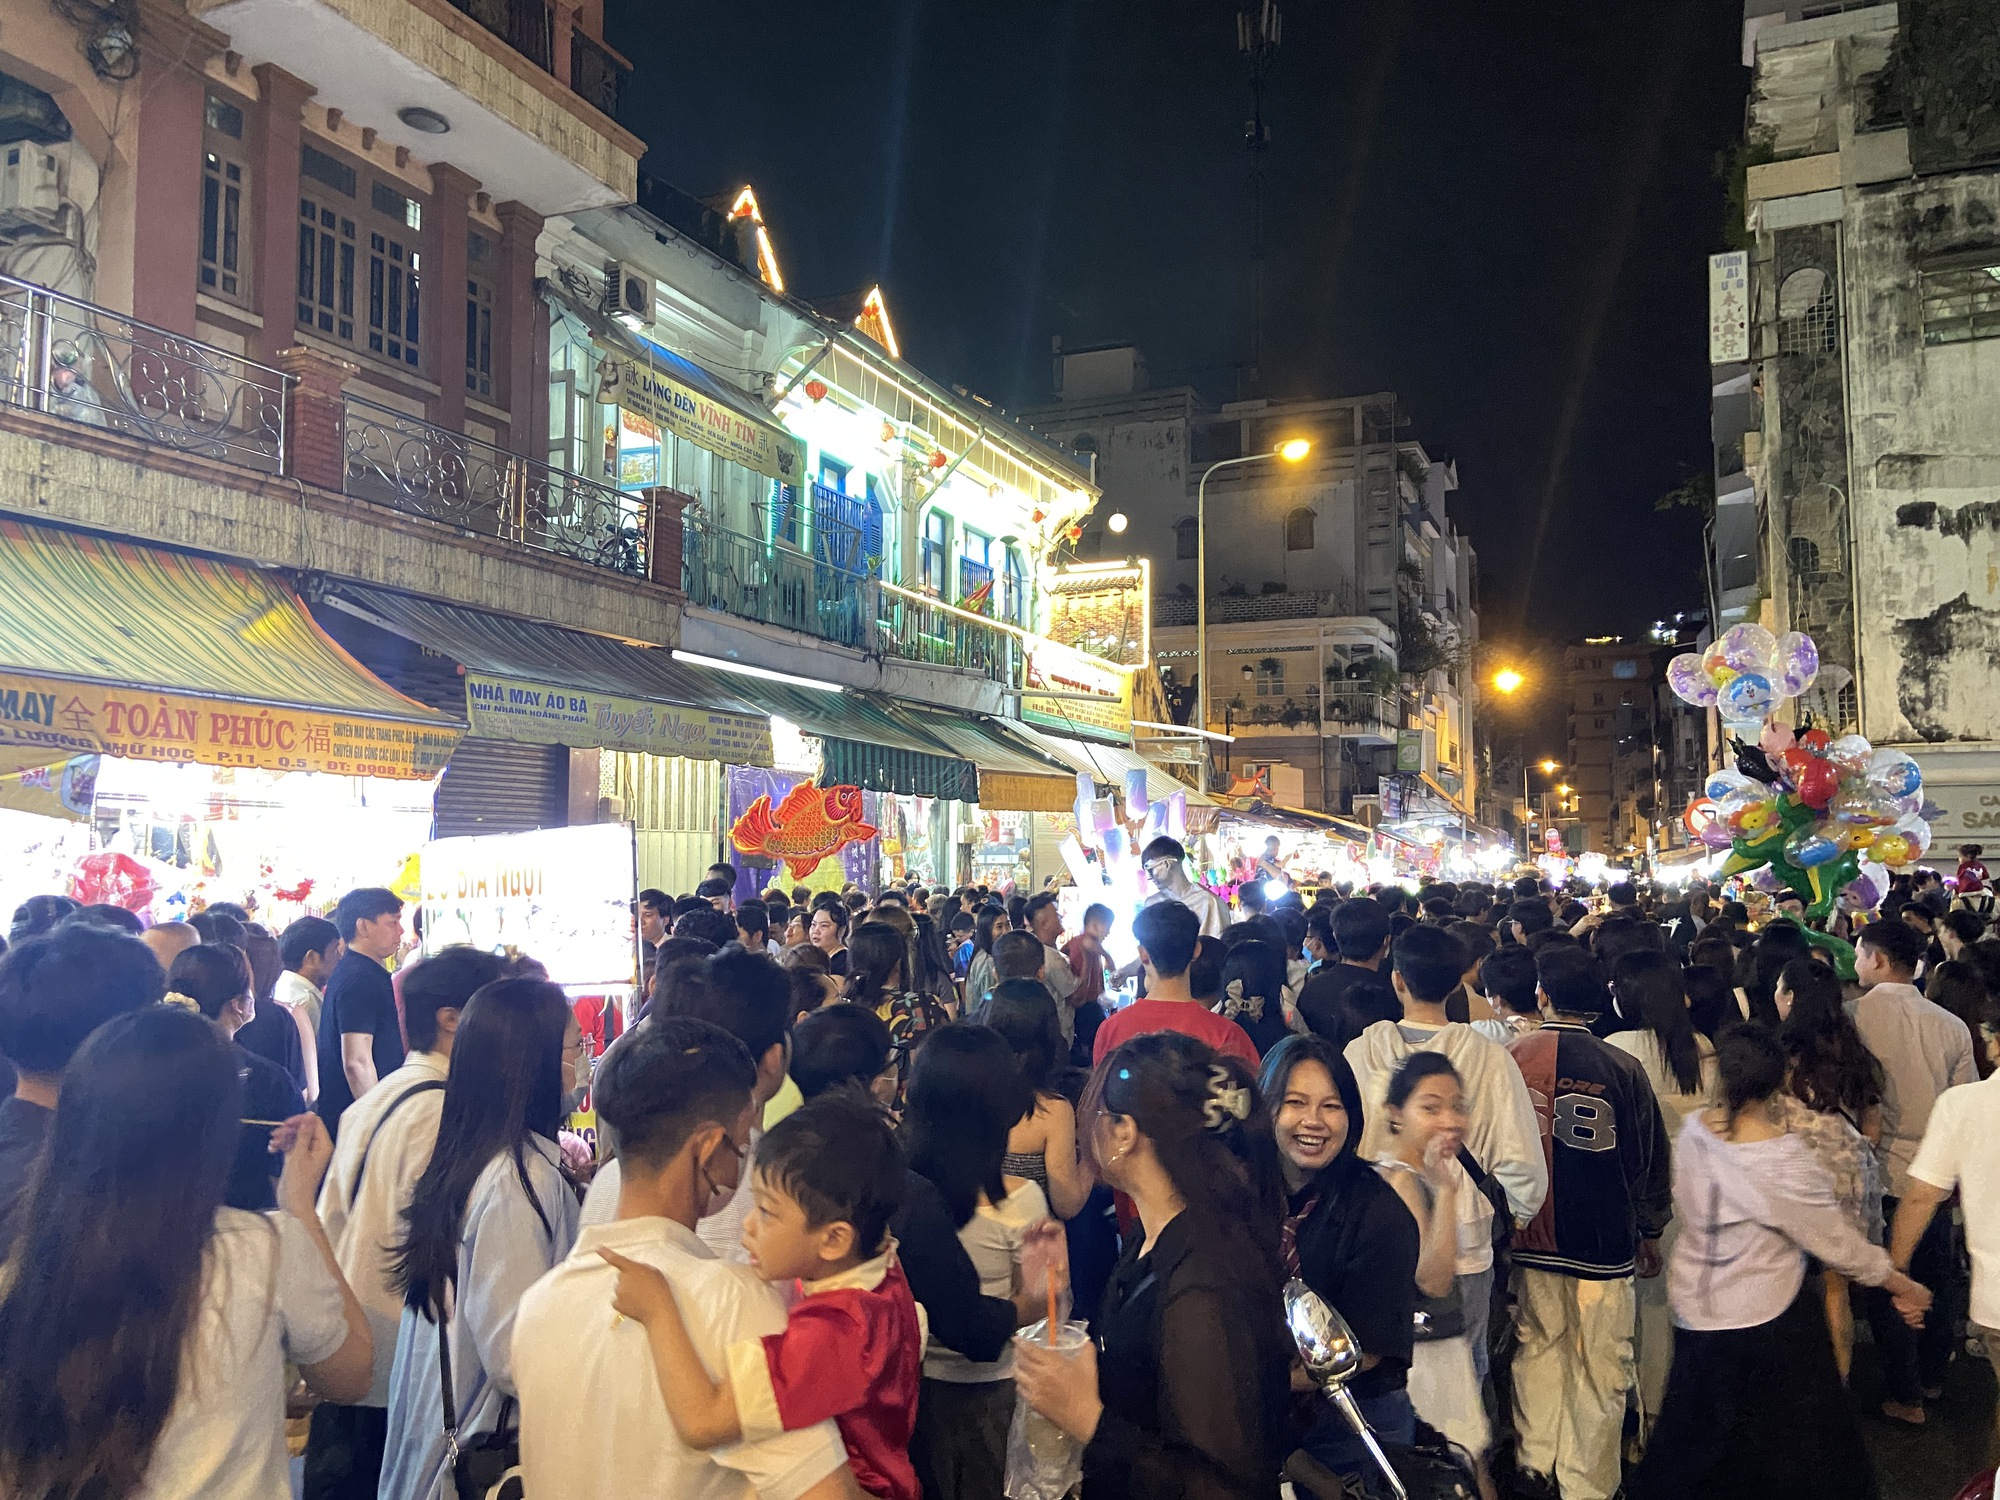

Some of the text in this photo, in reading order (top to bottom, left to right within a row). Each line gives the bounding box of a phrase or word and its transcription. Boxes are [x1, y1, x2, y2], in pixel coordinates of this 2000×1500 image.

[674, 392, 697, 415] ĐÈN
[699, 402, 731, 434] VĨNH
[734, 419, 756, 446] TÍN
[470, 682, 588, 714] NHÀ MAY ÁO BÀ
[0, 688, 331, 755] MAY 全 TOÀN PHÚC 福
[333, 721, 353, 737] CHUYÊN
[354, 725, 364, 740] MAY
[365, 723, 376, 740] CÁC
[592, 702, 656, 738] Tuyết
[659, 712, 707, 745] Nga
[151, 746, 195, 760] HỌC
[217, 752, 256, 765] P.11
[278, 756, 307, 769] Q.5
[326, 761, 351, 772] ĐT:
[333, 742, 353, 758] CHUYÊN
[354, 747, 363, 760] GIA
[364, 744, 378, 761] CÔNG
[379, 744, 389, 762] CÁC
